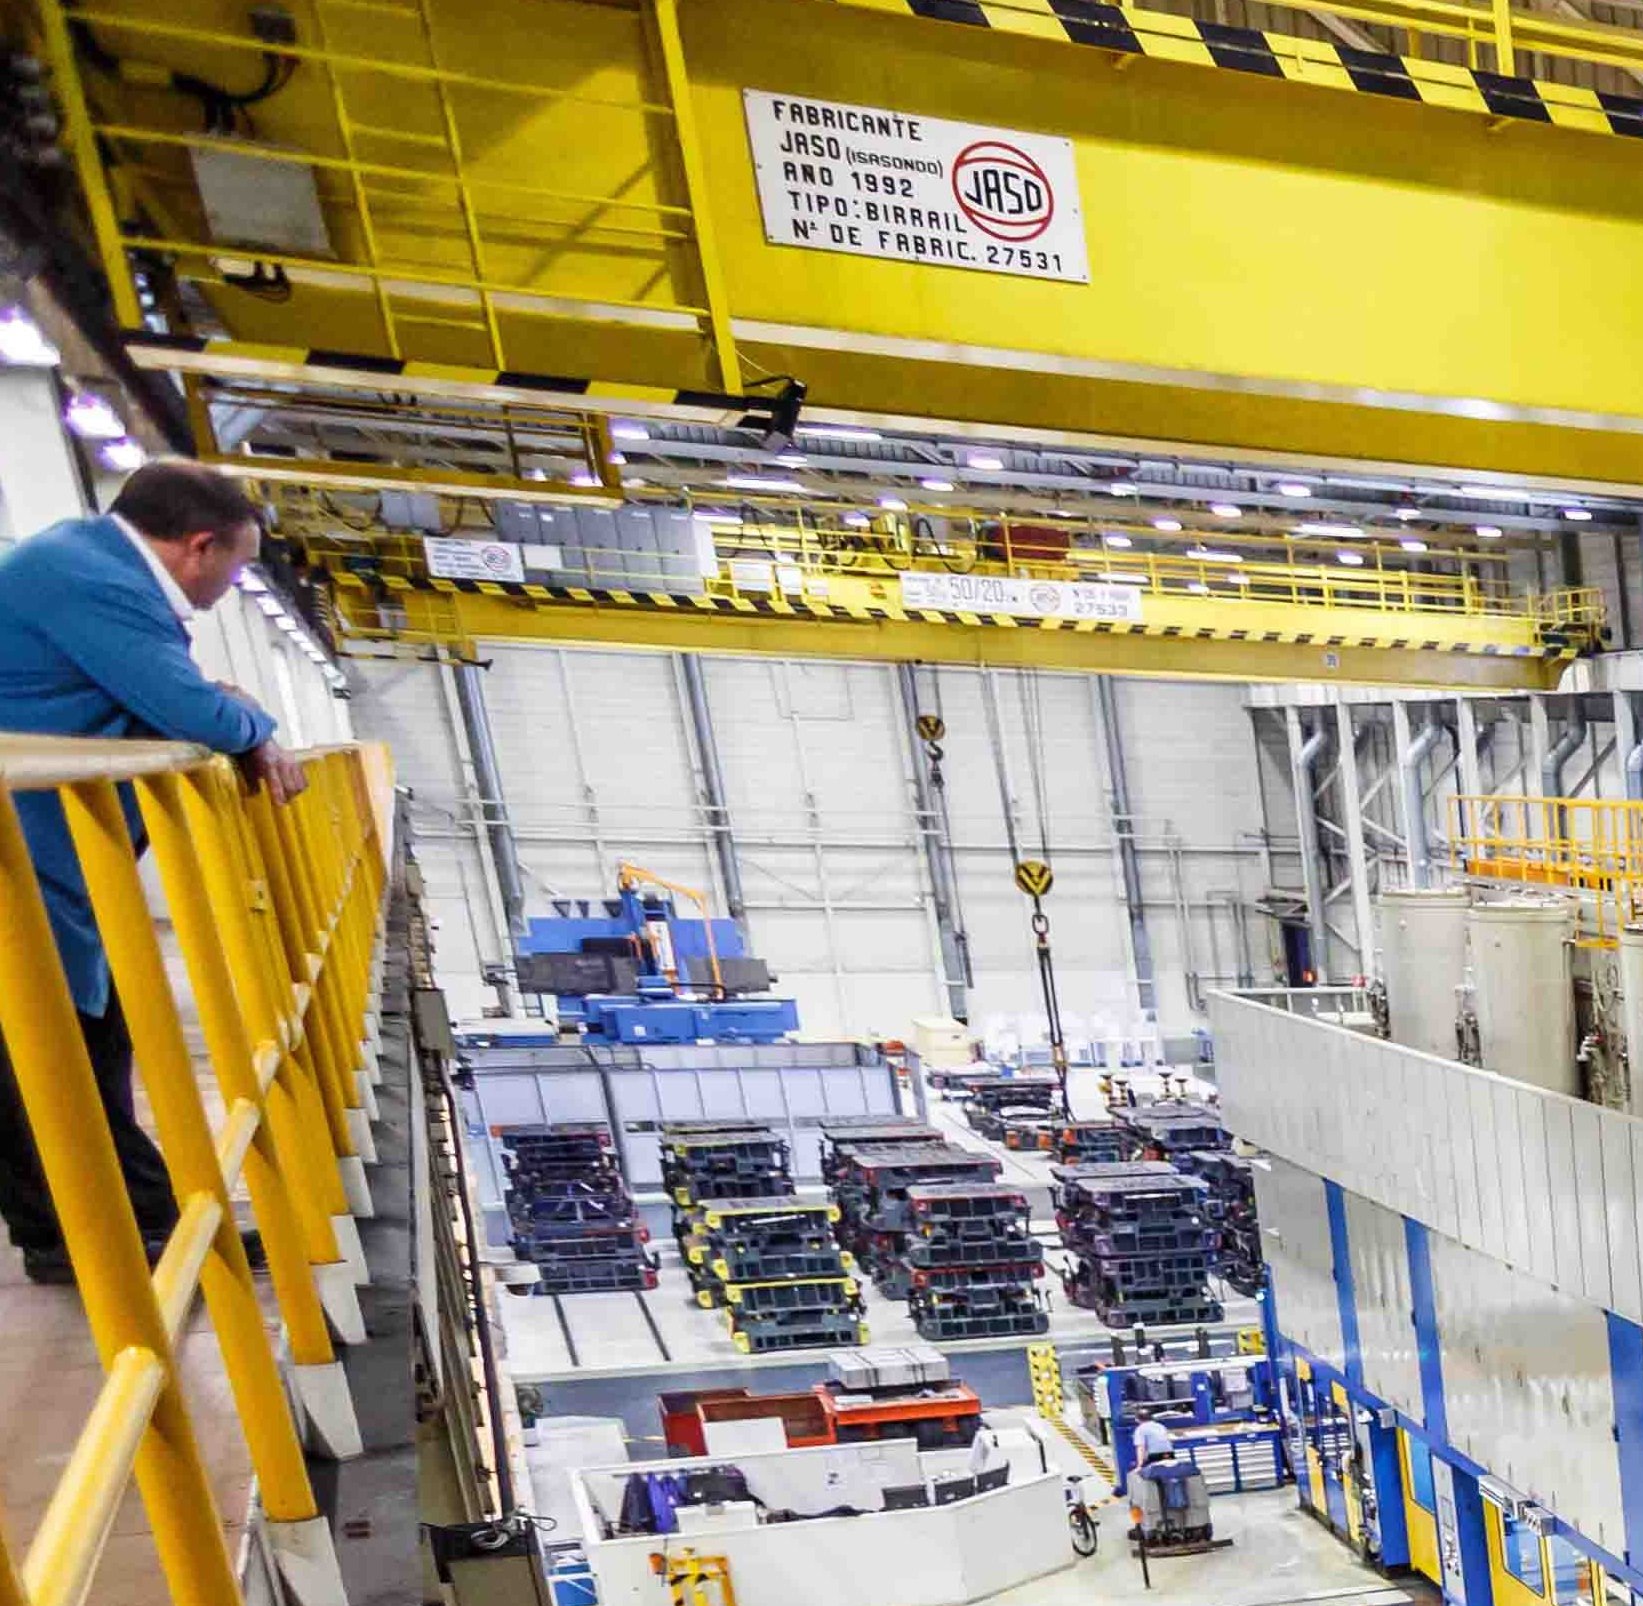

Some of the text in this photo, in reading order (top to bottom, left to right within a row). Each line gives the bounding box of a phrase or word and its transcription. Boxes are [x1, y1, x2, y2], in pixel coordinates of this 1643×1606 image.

[773, 100, 923, 142] FABRICANTE
[781, 131, 944, 179] JASO (ISASONDO)
[851, 171, 914, 199] 1992
[965, 169, 1043, 215] JASO
[830, 223, 862, 247] DE
[878, 230, 976, 262] FABRIC.
[986, 245, 1062, 273] 27531
